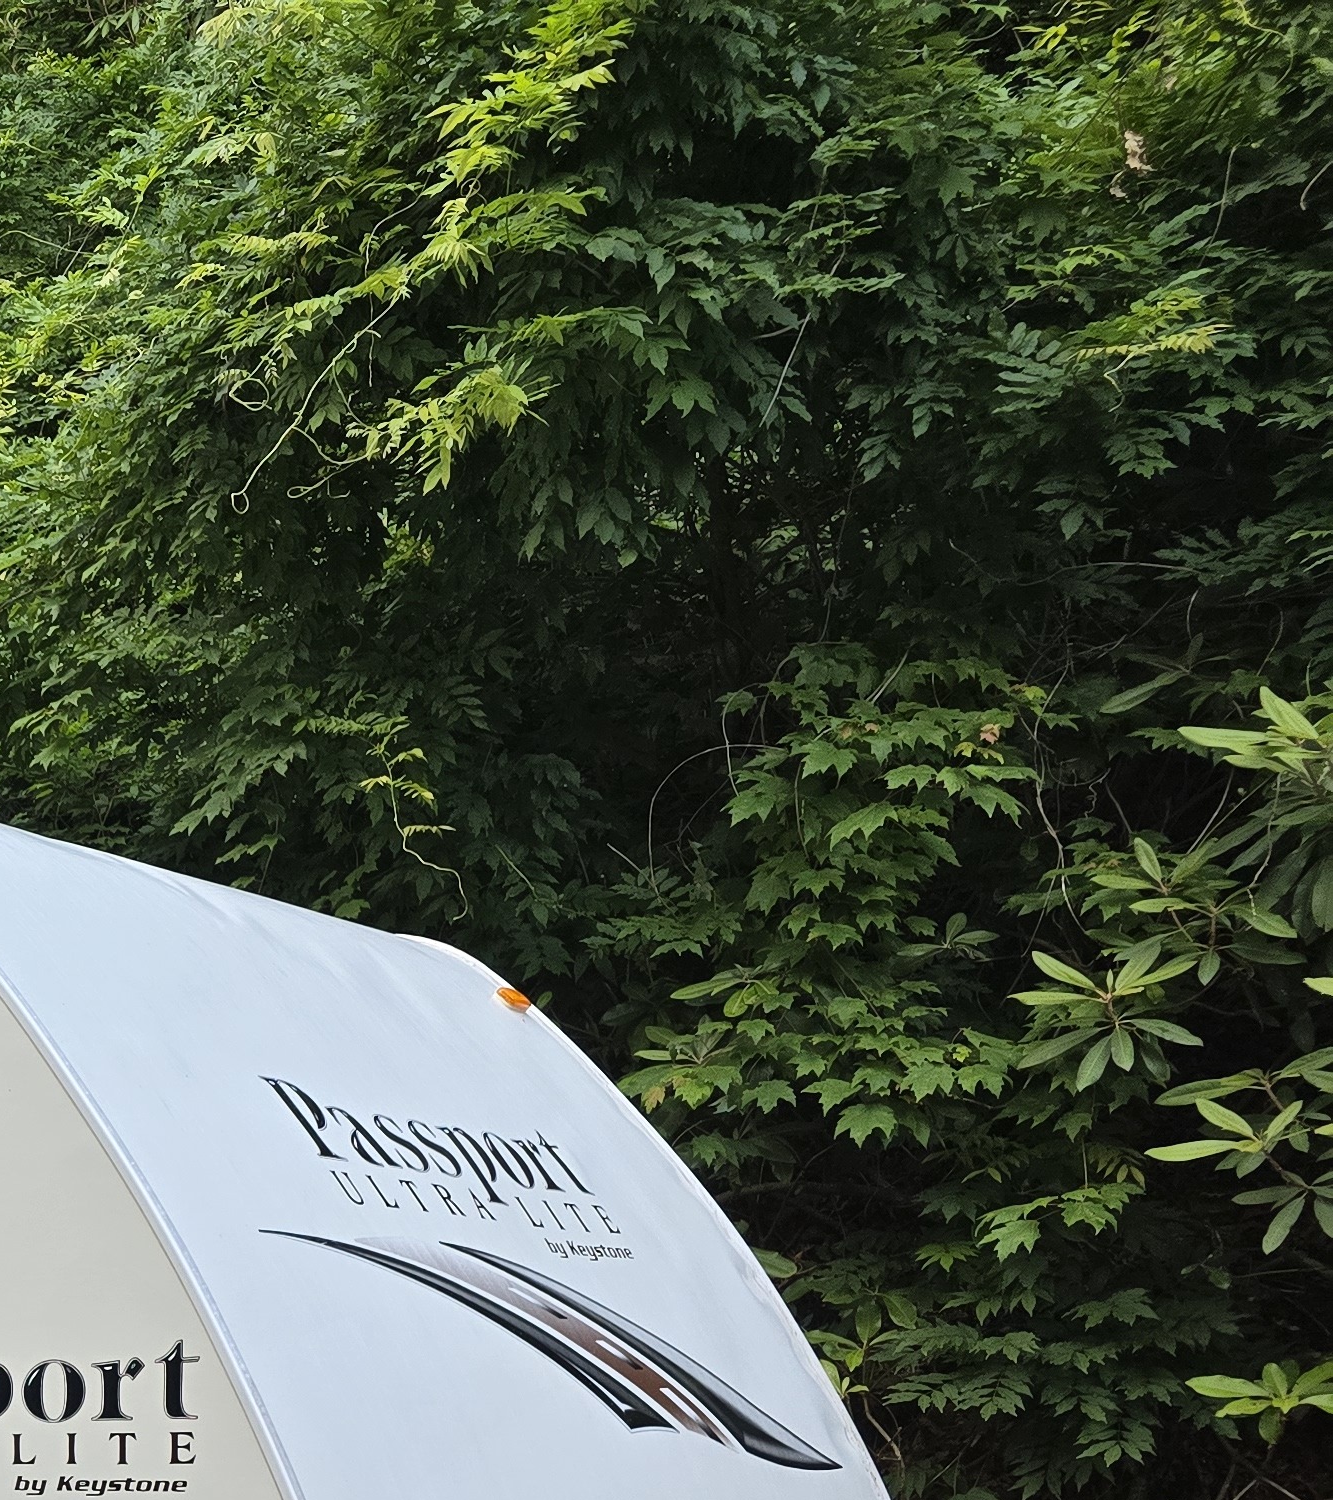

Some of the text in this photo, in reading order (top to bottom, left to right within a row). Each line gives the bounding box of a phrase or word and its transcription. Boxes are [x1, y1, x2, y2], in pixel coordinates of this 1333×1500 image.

[257, 1074, 596, 1207] Passport
[329, 1169, 622, 1235] ULTRA LITE
[544, 1237, 635, 1262] by Keystone
[11, 1431, 197, 1466] LITE
[13, 1475, 189, 1497] by Keystone
